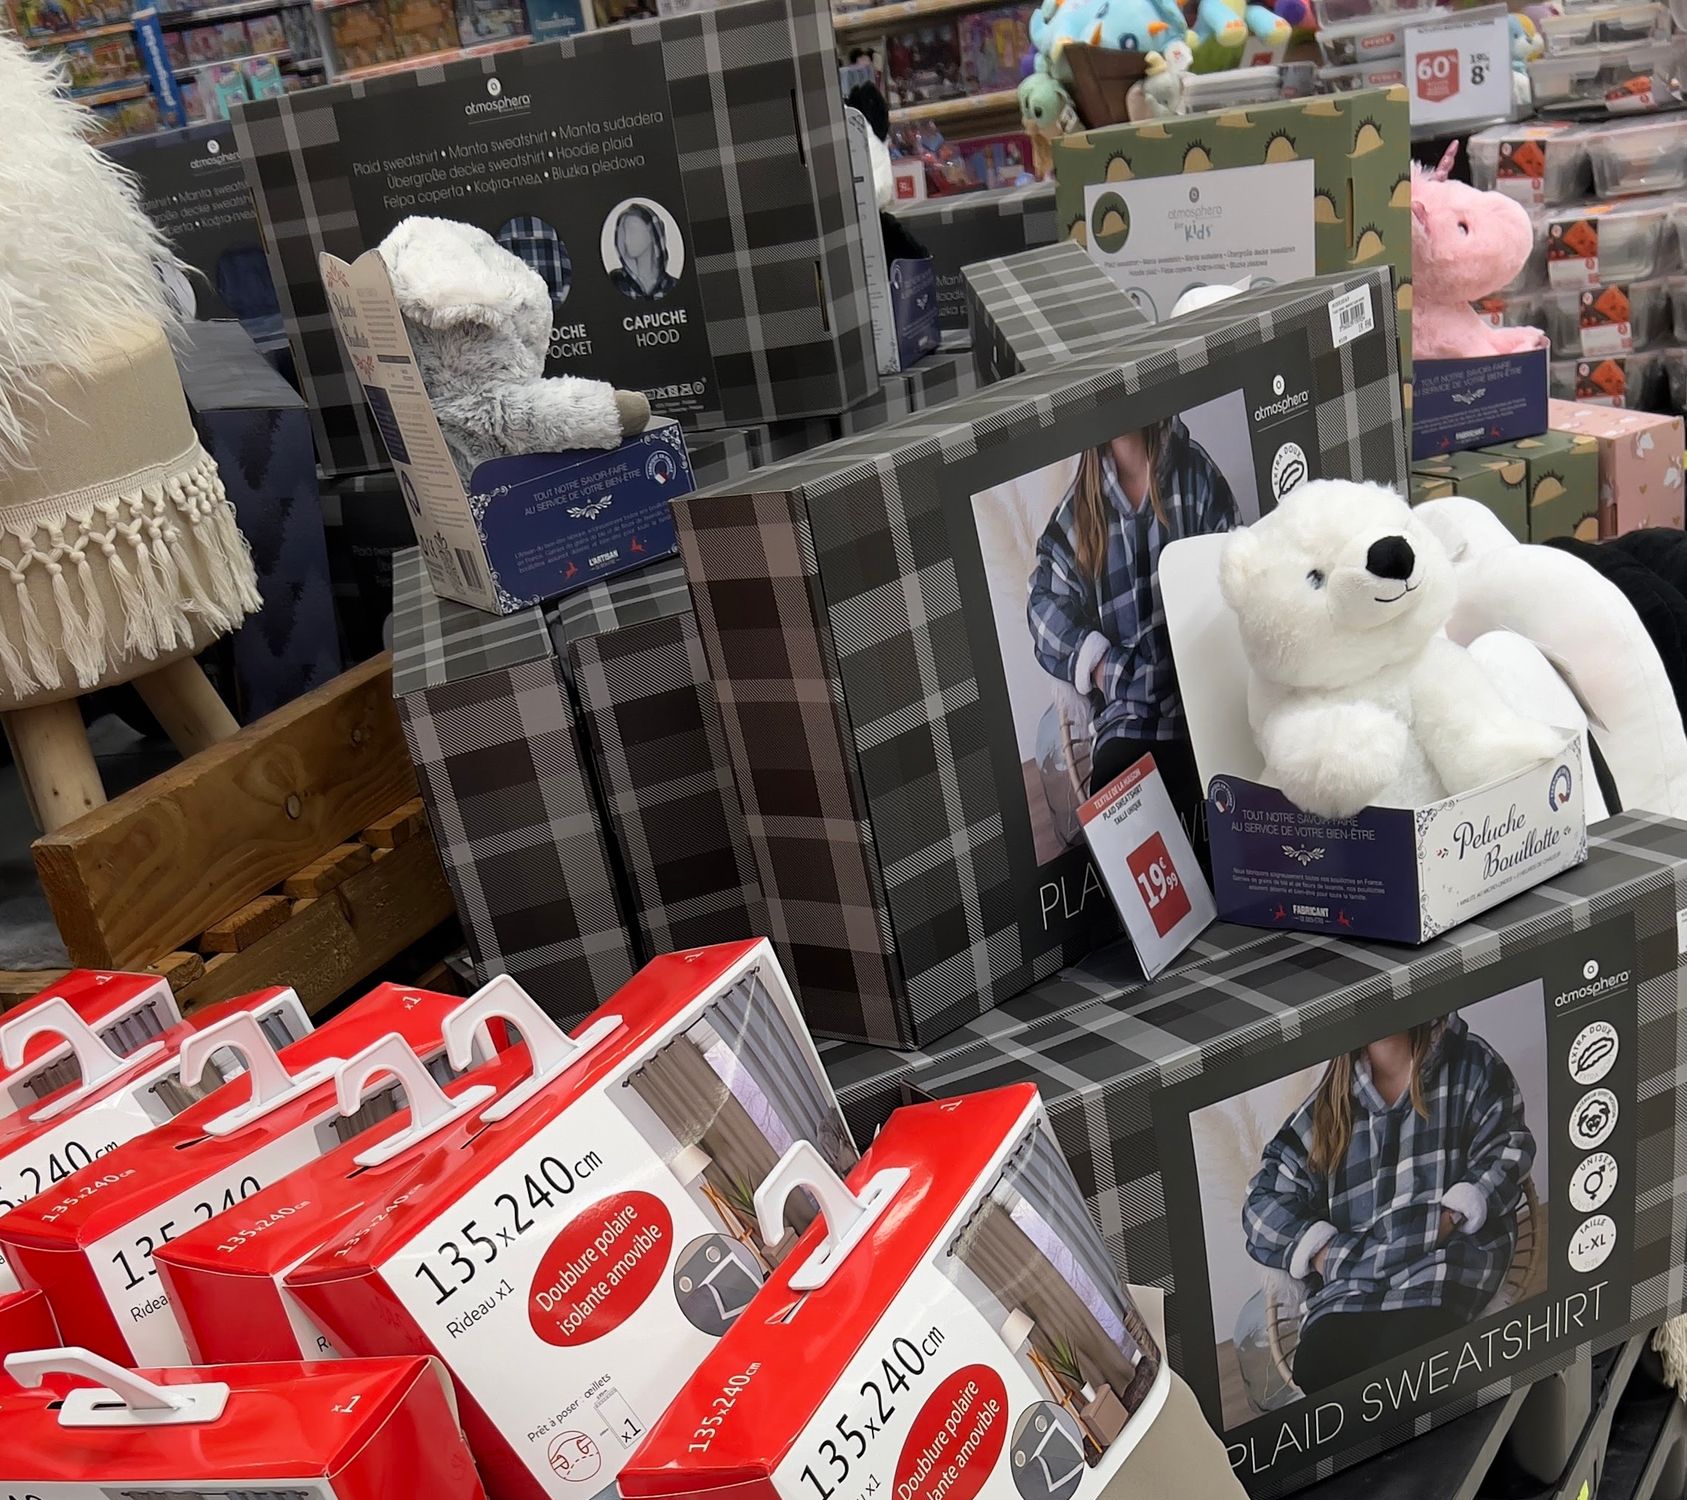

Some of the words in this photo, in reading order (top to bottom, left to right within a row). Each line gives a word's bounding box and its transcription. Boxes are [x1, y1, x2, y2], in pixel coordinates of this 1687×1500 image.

[465, 94, 532, 116] atmosphera
[353, 161, 381, 176] Plaid
[383, 150, 439, 171] sweatshirt
[449, 141, 489, 159] Manta
[491, 130, 548, 152] sweatshirt
[559, 121, 601, 139] Manta
[603, 110, 664, 132] sudadera
[387, 170, 447, 190] Übergroße
[449, 161, 485, 179] decke
[488, 149, 546, 171] sweatshirt
[556, 141, 600, 160] Hoodie
[602, 134, 633, 154] plaid
[551, 164, 590, 181] Bluzka
[591, 154, 645, 177] pledowa
[384, 194, 415, 209] Felpa
[417, 184, 464, 204] coperta
[550, 324, 587, 341] OCHE
[623, 309, 688, 331] CAPUCHE
[636, 329, 680, 347] HOOD
[1254, 390, 1309, 421] atmosphera
[1231, 821, 1242, 832] AU
[1244, 822, 1279, 836] SERVICE
[1281, 825, 1293, 836] DE
[1295, 826, 1324, 839] VOTRE
[1242, 809, 1264, 822] TOUT
[1266, 811, 1295, 824] NOTRE
[1453, 803, 1525, 860] Peluche
[1483, 827, 1560, 880] Bouillotte
[1039, 862, 1105, 930] PLA
[1555, 970, 1631, 1007] atmosphera
[1571, 1033, 1587, 1065] EXTRA
[1589, 1024, 1612, 1036] DOUX
[1580, 1154, 1617, 1173] UNISEXE
[1580, 1218, 1607, 1235] TAILLE
[536, 1246, 599, 1312] Doublure
[594, 1204, 638, 1256] polaire
[1577, 1233, 1608, 1256] L-XL
[556, 1281, 611, 1337] isolante
[607, 1222, 663, 1287] amovible
[130, 1292, 169, 1322] Ridea
[447, 1292, 496, 1339] Rideau
[495, 1277, 515, 1301] x1
[1227, 1401, 1345, 1475] PLAID
[1361, 1281, 1610, 1423] SWEATSHIRT
[331, 1393, 361, 1415] x1
[945, 1380, 979, 1438] polaire
[527, 1425, 550, 1442] Prêt
[550, 1418, 557, 1427] à
[556, 1399, 579, 1424] poser
[621, 1418, 641, 1443] x1
[954, 1398, 1001, 1470] amovible
[865, 1473, 882, 1498] x1
